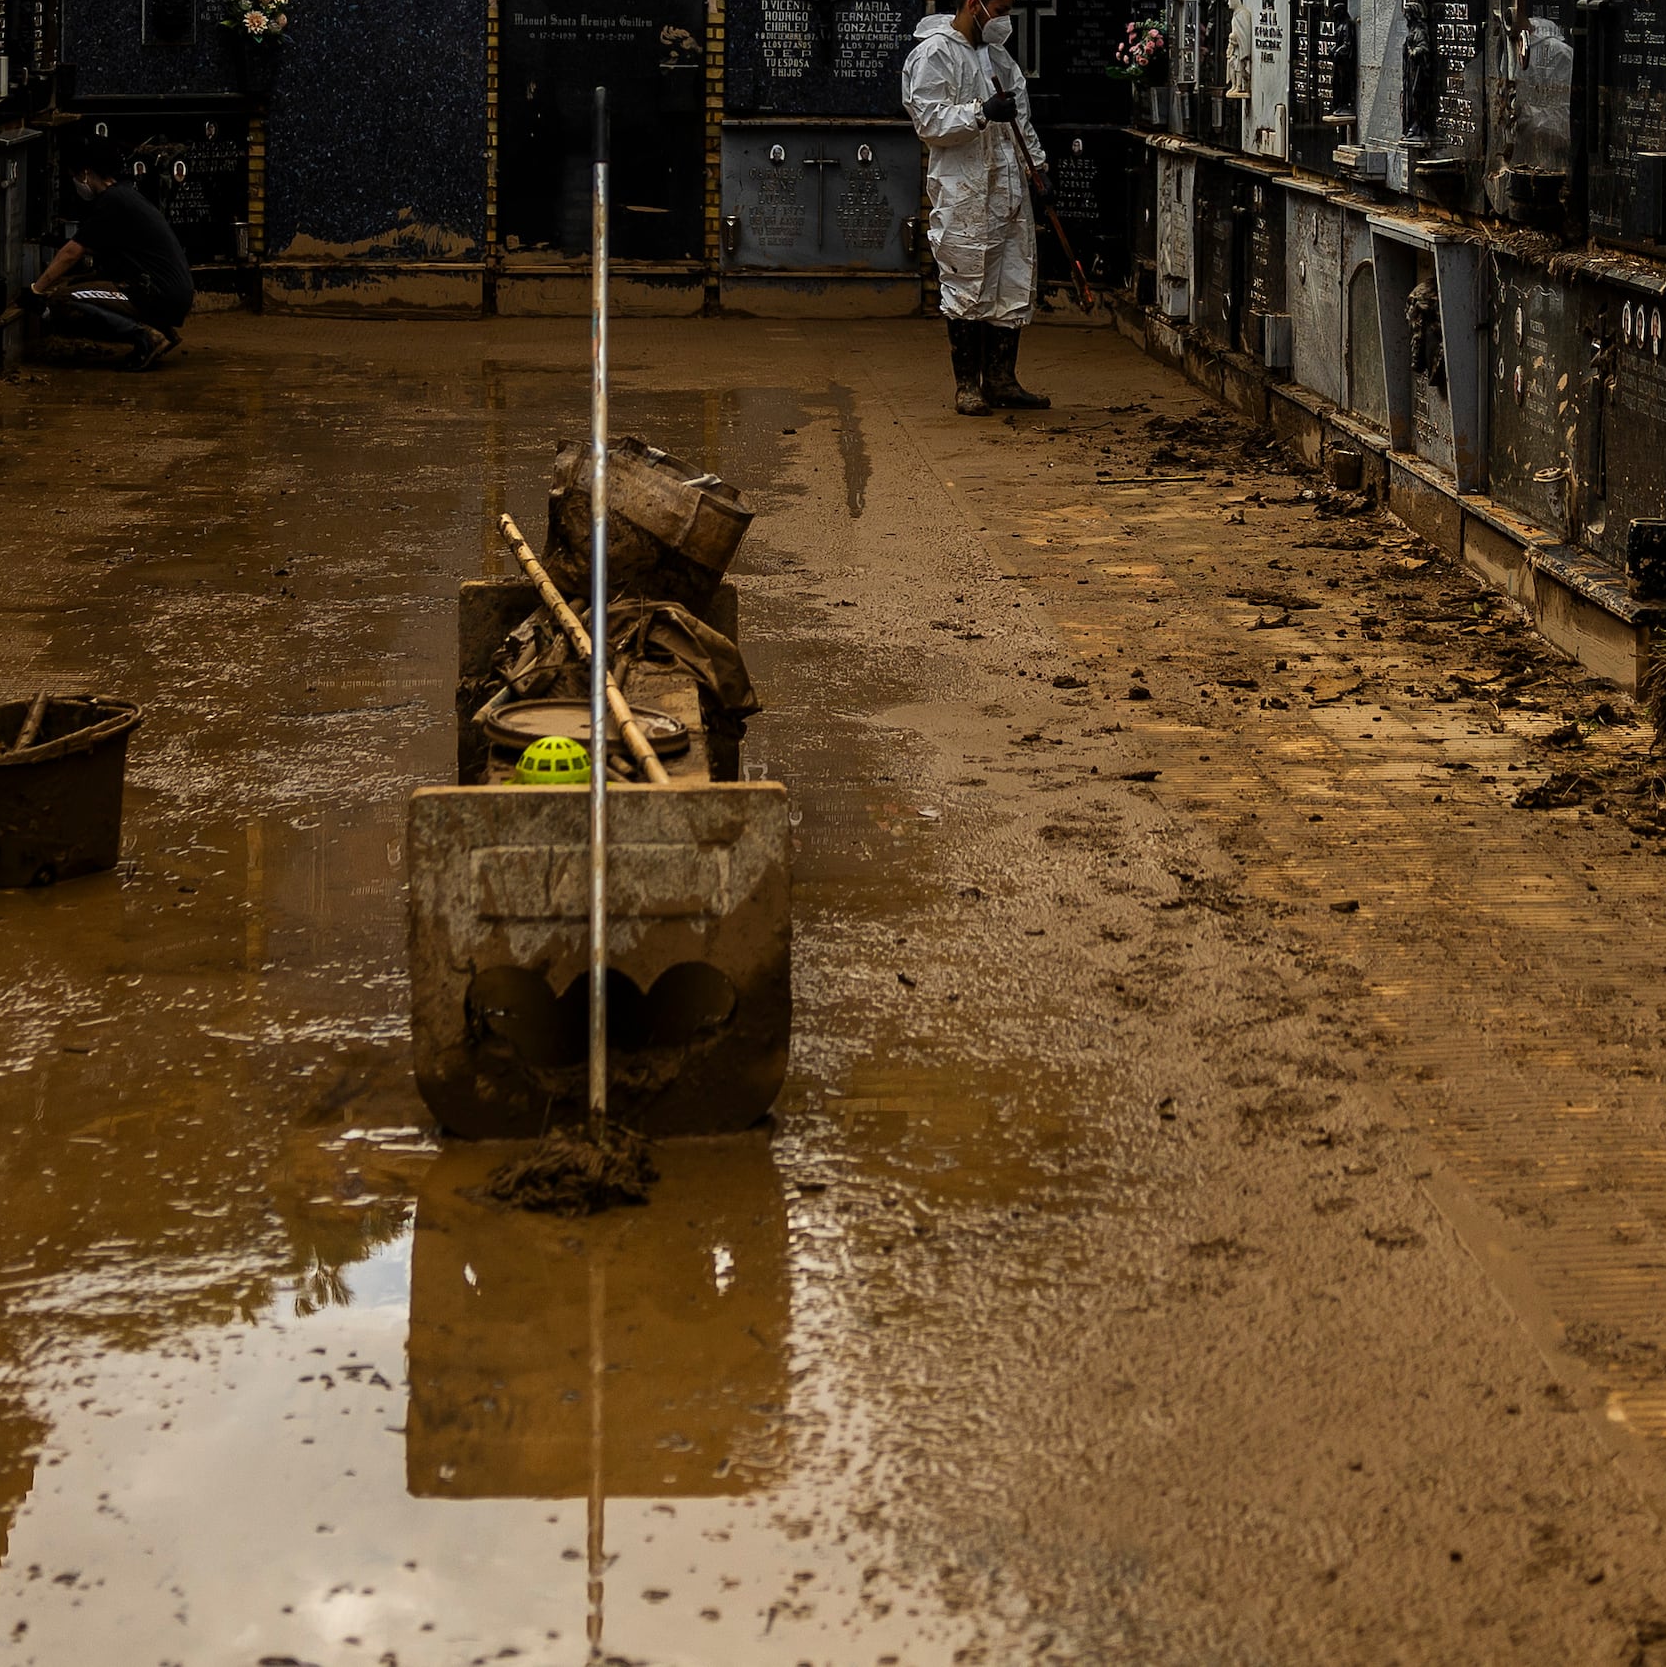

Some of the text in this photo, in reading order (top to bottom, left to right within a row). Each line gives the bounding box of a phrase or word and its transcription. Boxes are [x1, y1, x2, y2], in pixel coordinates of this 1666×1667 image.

[854, 1, 891, 12] MARIA
[513, 13, 547, 26] Manuel
[550, 13, 577, 26] Santa
[619, 14, 653, 27] Guillem
[764, 11, 809, 22] RODRIGO
[835, 12, 902, 22] FERNANDEZ
[837, 22, 898, 33] GONZALEZ
[834, 59, 884, 69] TUS HIJOS
